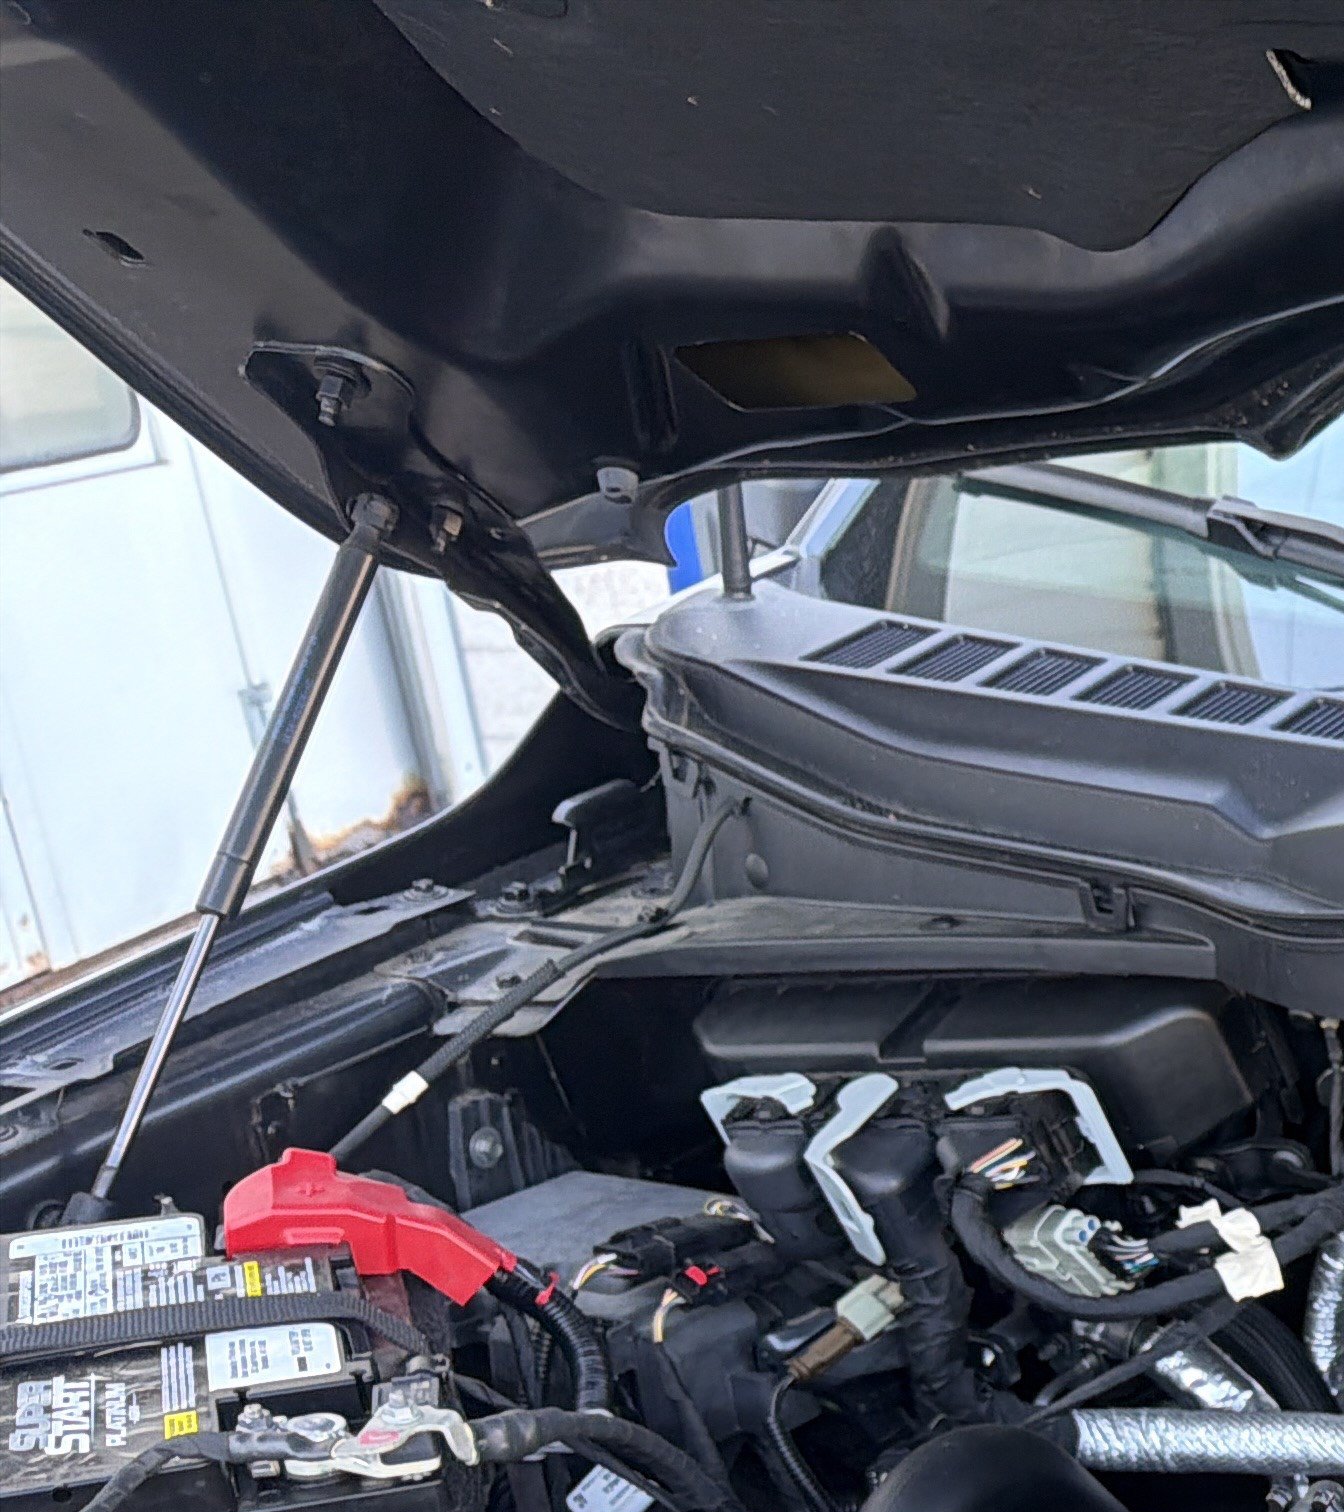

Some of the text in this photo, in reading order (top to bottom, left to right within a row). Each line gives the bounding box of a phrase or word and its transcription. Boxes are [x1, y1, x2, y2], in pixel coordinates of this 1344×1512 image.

[9, 1381, 52, 1451] SUPER
[45, 1375, 91, 1455] START
[105, 1382, 127, 1447] PLATINUM
